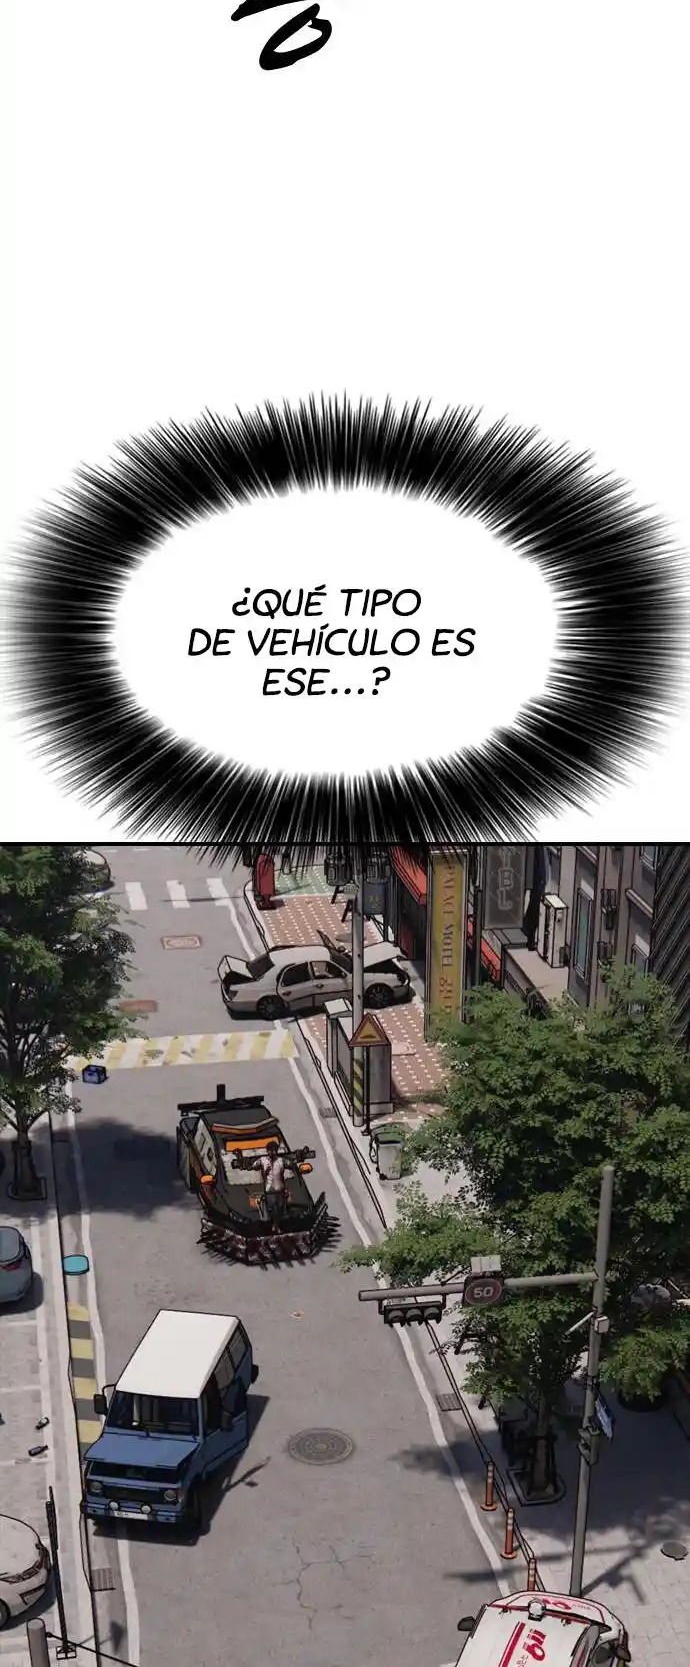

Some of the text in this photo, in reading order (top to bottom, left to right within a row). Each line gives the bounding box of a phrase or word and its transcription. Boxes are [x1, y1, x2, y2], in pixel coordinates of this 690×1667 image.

[231, 584, 422, 619] ¿QUÉ TIPO
[187, 623, 476, 657] DE VEHÍCULO ES
[262, 666, 391, 697] ESE...?
[440, 923, 454, 967] MOTEL
[473, 1286, 494, 1299] 50
